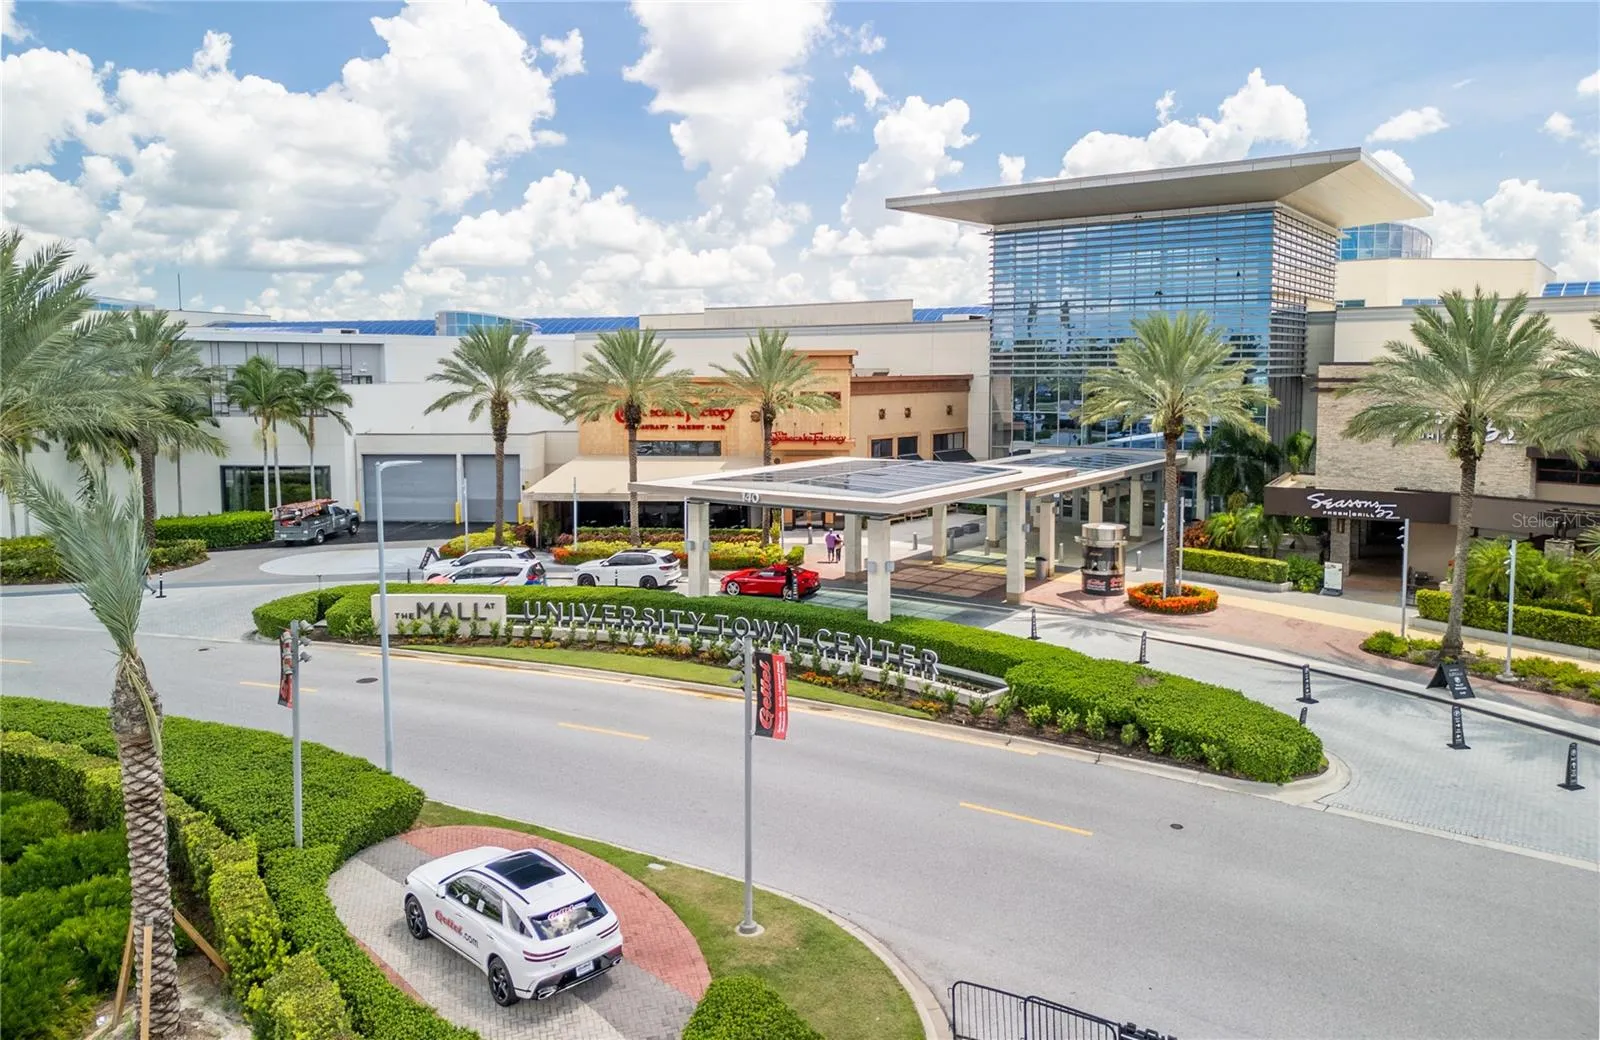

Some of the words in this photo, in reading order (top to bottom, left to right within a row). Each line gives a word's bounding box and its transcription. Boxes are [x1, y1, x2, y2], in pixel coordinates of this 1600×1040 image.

[1307, 493, 1380, 509] Seasons
[1374, 504, 1400, 519] 52
[394, 612, 415, 620] THE
[416, 601, 487, 620] MALL
[523, 600, 706, 633] UNIVERSITY
[713, 614, 800, 648] TOWN
[812, 628, 939, 677] CENTER
[759, 659, 775, 729] Gettel
